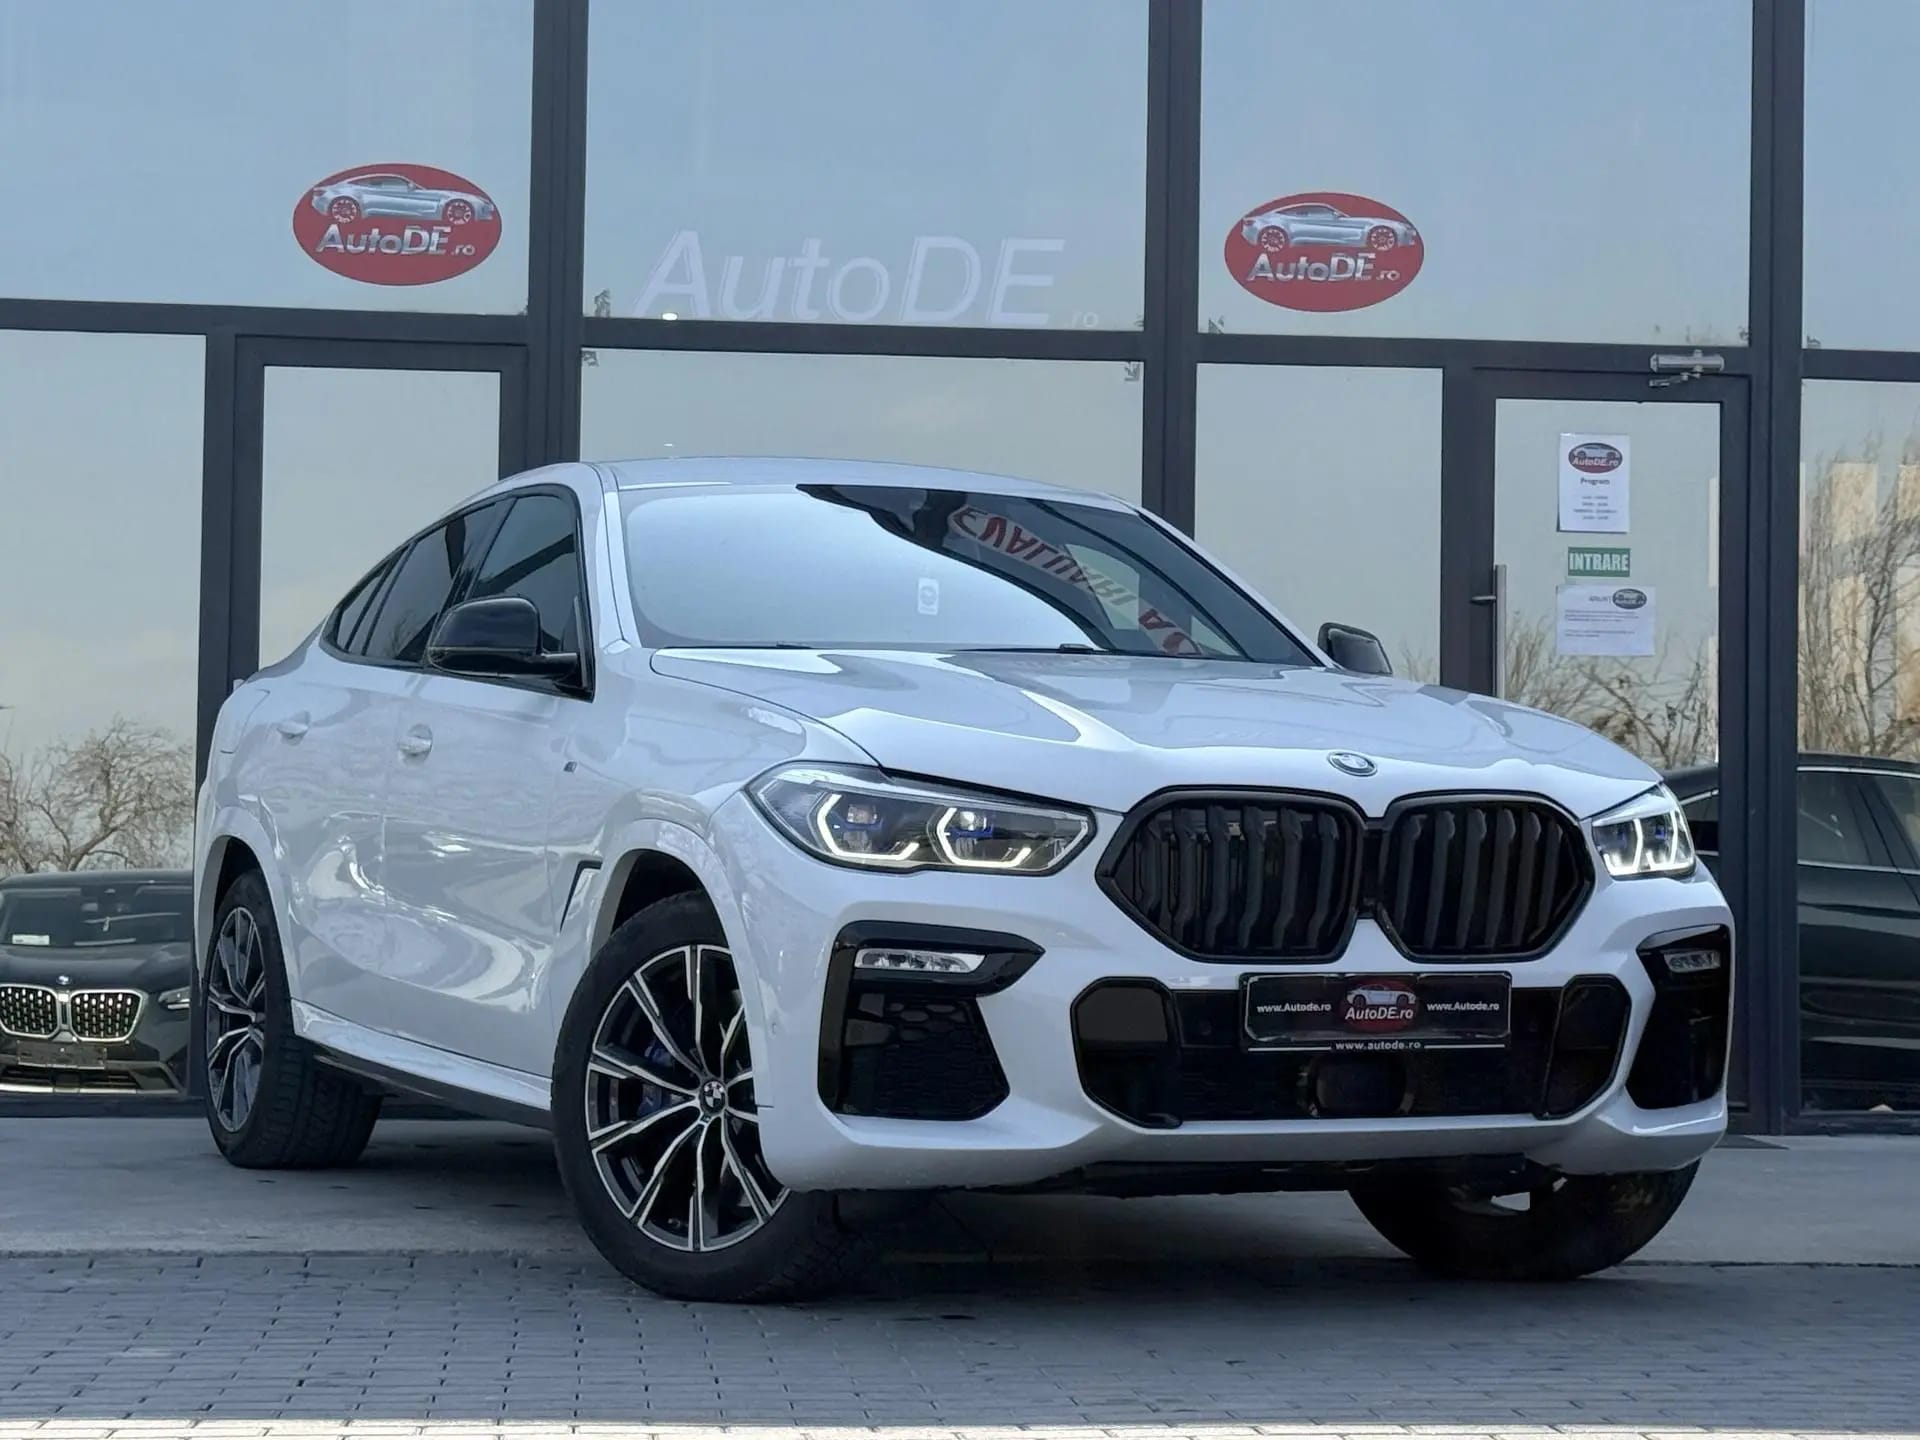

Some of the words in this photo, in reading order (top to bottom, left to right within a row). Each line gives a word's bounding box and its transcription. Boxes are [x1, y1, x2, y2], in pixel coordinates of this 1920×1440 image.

[1569, 553, 1629, 571] INTRARE
[1256, 1002, 1332, 1013] www.Autode.ro
[1427, 1001, 1500, 1012] www.Autode.ro
[1345, 1006, 1414, 1021] AutoDE.ro
[1335, 1040, 1422, 1051] www.autode.ro
